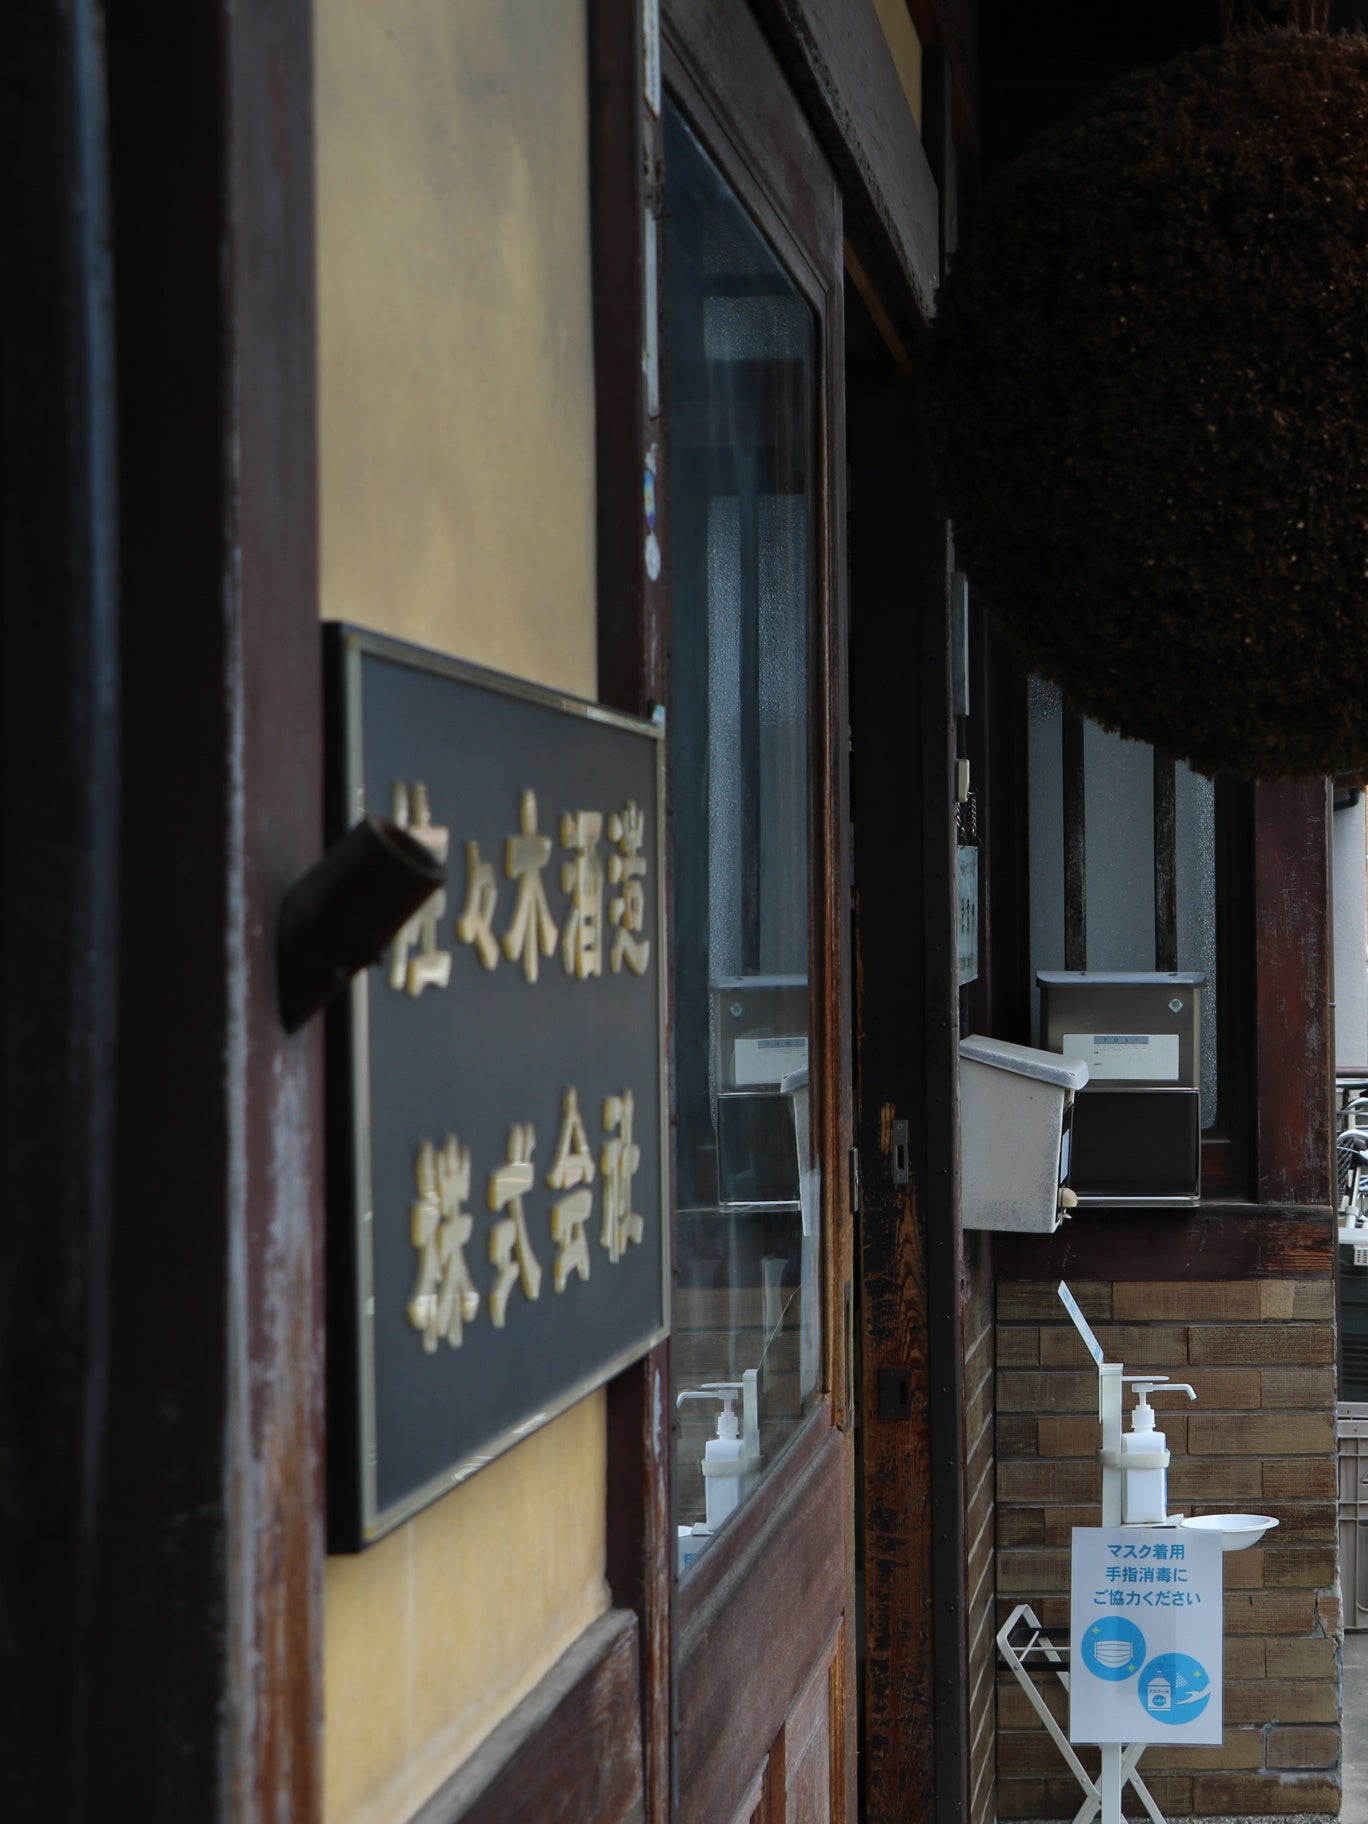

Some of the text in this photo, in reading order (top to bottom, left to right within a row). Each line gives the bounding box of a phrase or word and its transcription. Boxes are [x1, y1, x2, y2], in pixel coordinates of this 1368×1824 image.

[409, 1085, 645, 1353] 株式会社
[1108, 1545, 1185, 1560] マスク着用
[1106, 1566, 1188, 1583] 手指消毒に
[1094, 1590, 1201, 1606] ご協力ください
